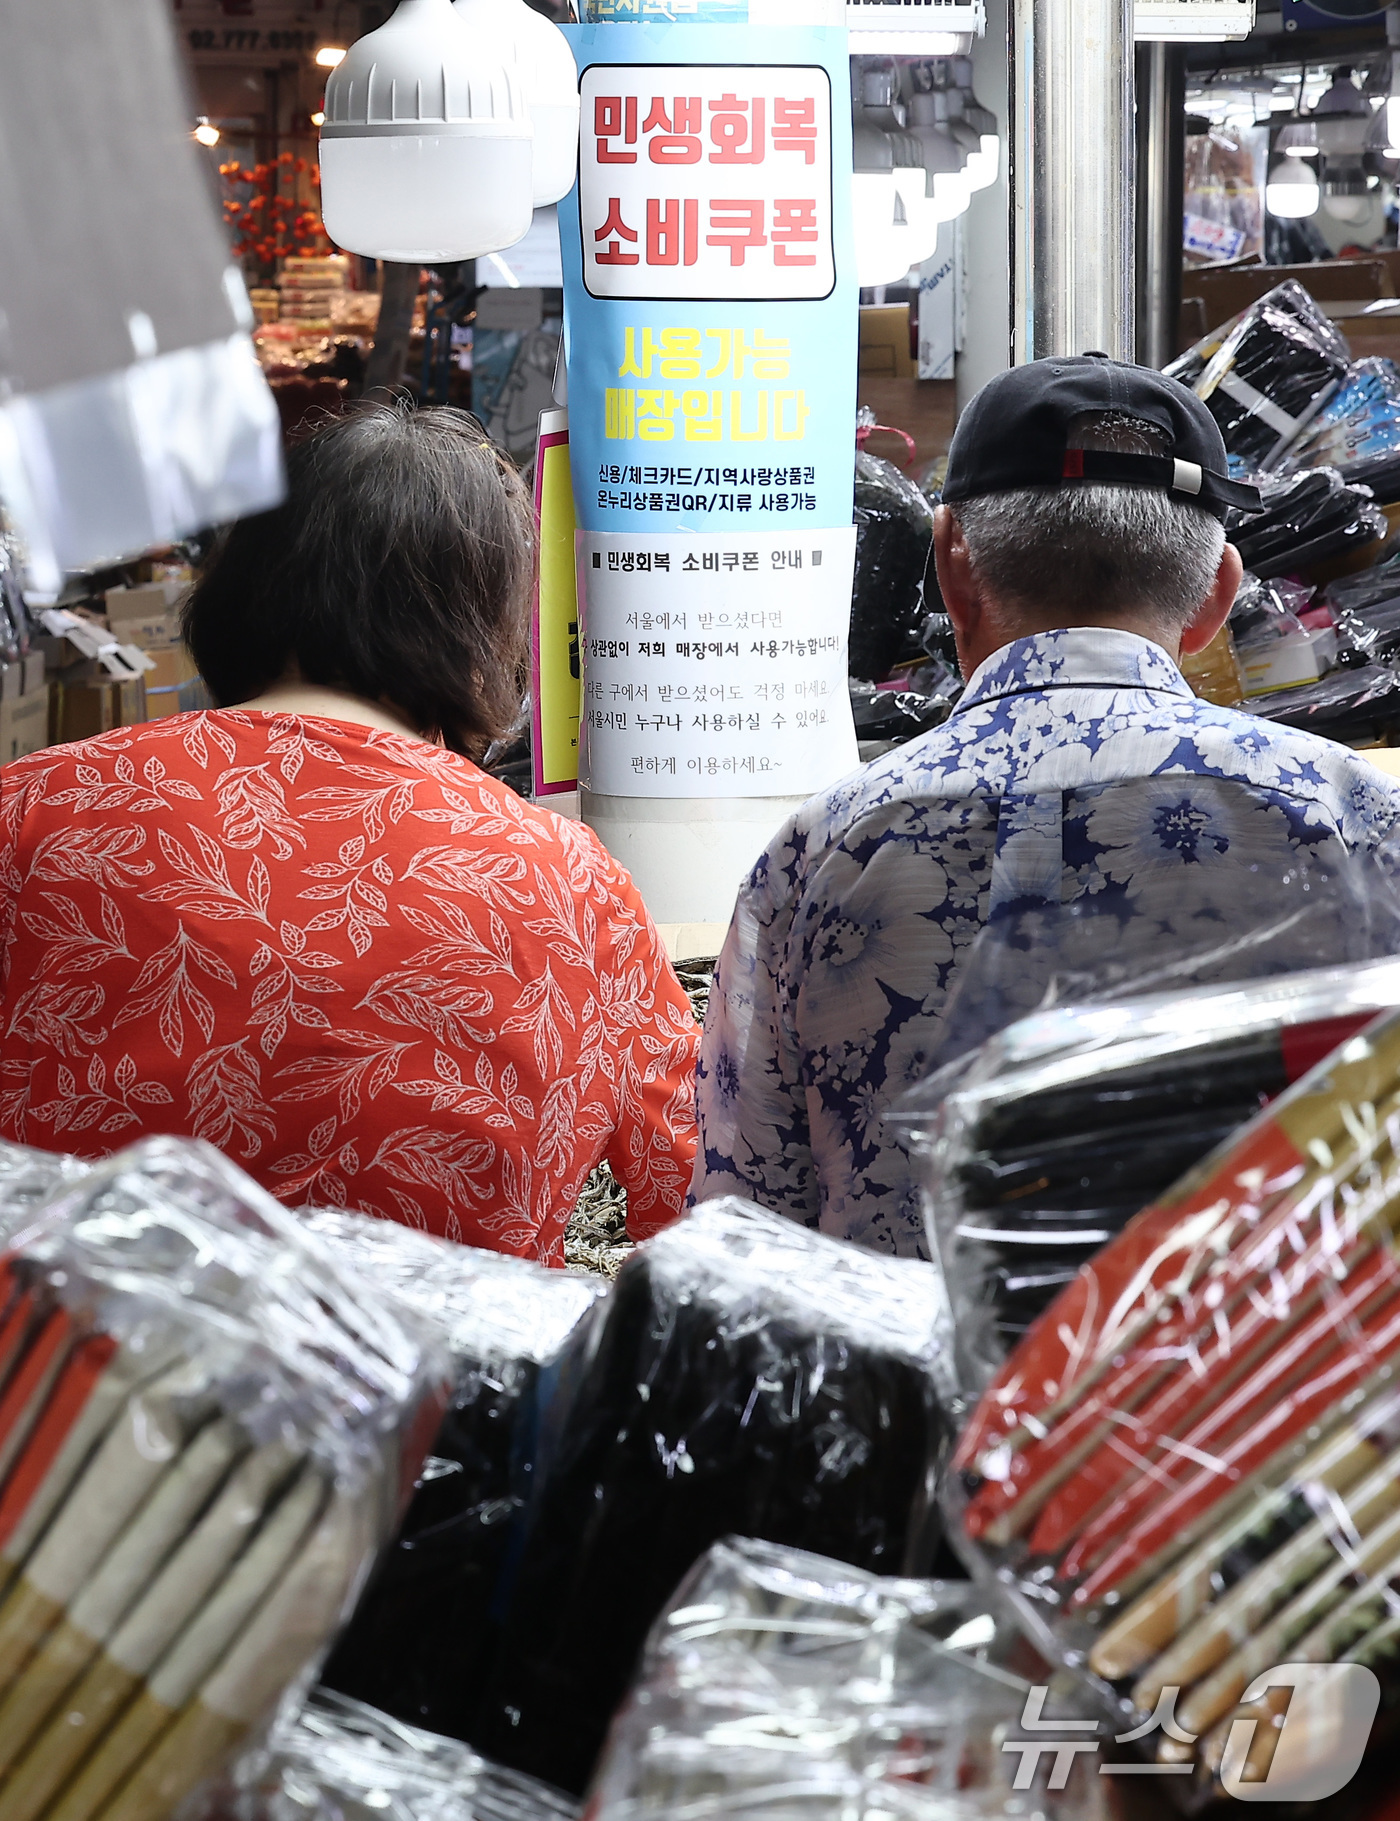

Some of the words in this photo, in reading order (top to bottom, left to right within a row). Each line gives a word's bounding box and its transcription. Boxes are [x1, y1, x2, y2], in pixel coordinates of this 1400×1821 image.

[594, 93, 818, 165] 민생회복
[594, 197, 819, 267] 소비쿠폰
[618, 326, 792, 380] 사용가능
[604, 387, 811, 442] 매장입니다
[598, 464, 815, 487] 신용/체크카드/지역사랑상품권
[597, 489, 752, 513] 온누리상품권QR/지류
[758, 492, 817, 512] 사용가능
[607, 551, 670, 572] 민생회복
[682, 552, 760, 572] 소비쿠폰
[770, 549, 802, 570] 안내
[625, 611, 687, 631] 서울에서
[697, 610, 783, 631] 받으셨다면
[590, 638, 630, 659] 상관없이
[638, 641, 666, 658] 저희
[675, 641, 740, 661] 매장에서
[750, 635, 840, 659] 사용가능합니다!
[587, 680, 604, 700] 다른
[609, 683, 648, 703] 구에서
[657, 683, 744, 703] 받으셨어도
[754, 682, 785, 702] 걱정
[587, 709, 628, 731] 서울시민
[634, 713, 683, 732] 누구나
[692, 712, 761, 732] 사용하실
[770, 712, 787, 730] 수
[630, 756, 676, 775] 편하게
[687, 755, 783, 775] 이용하세요~
